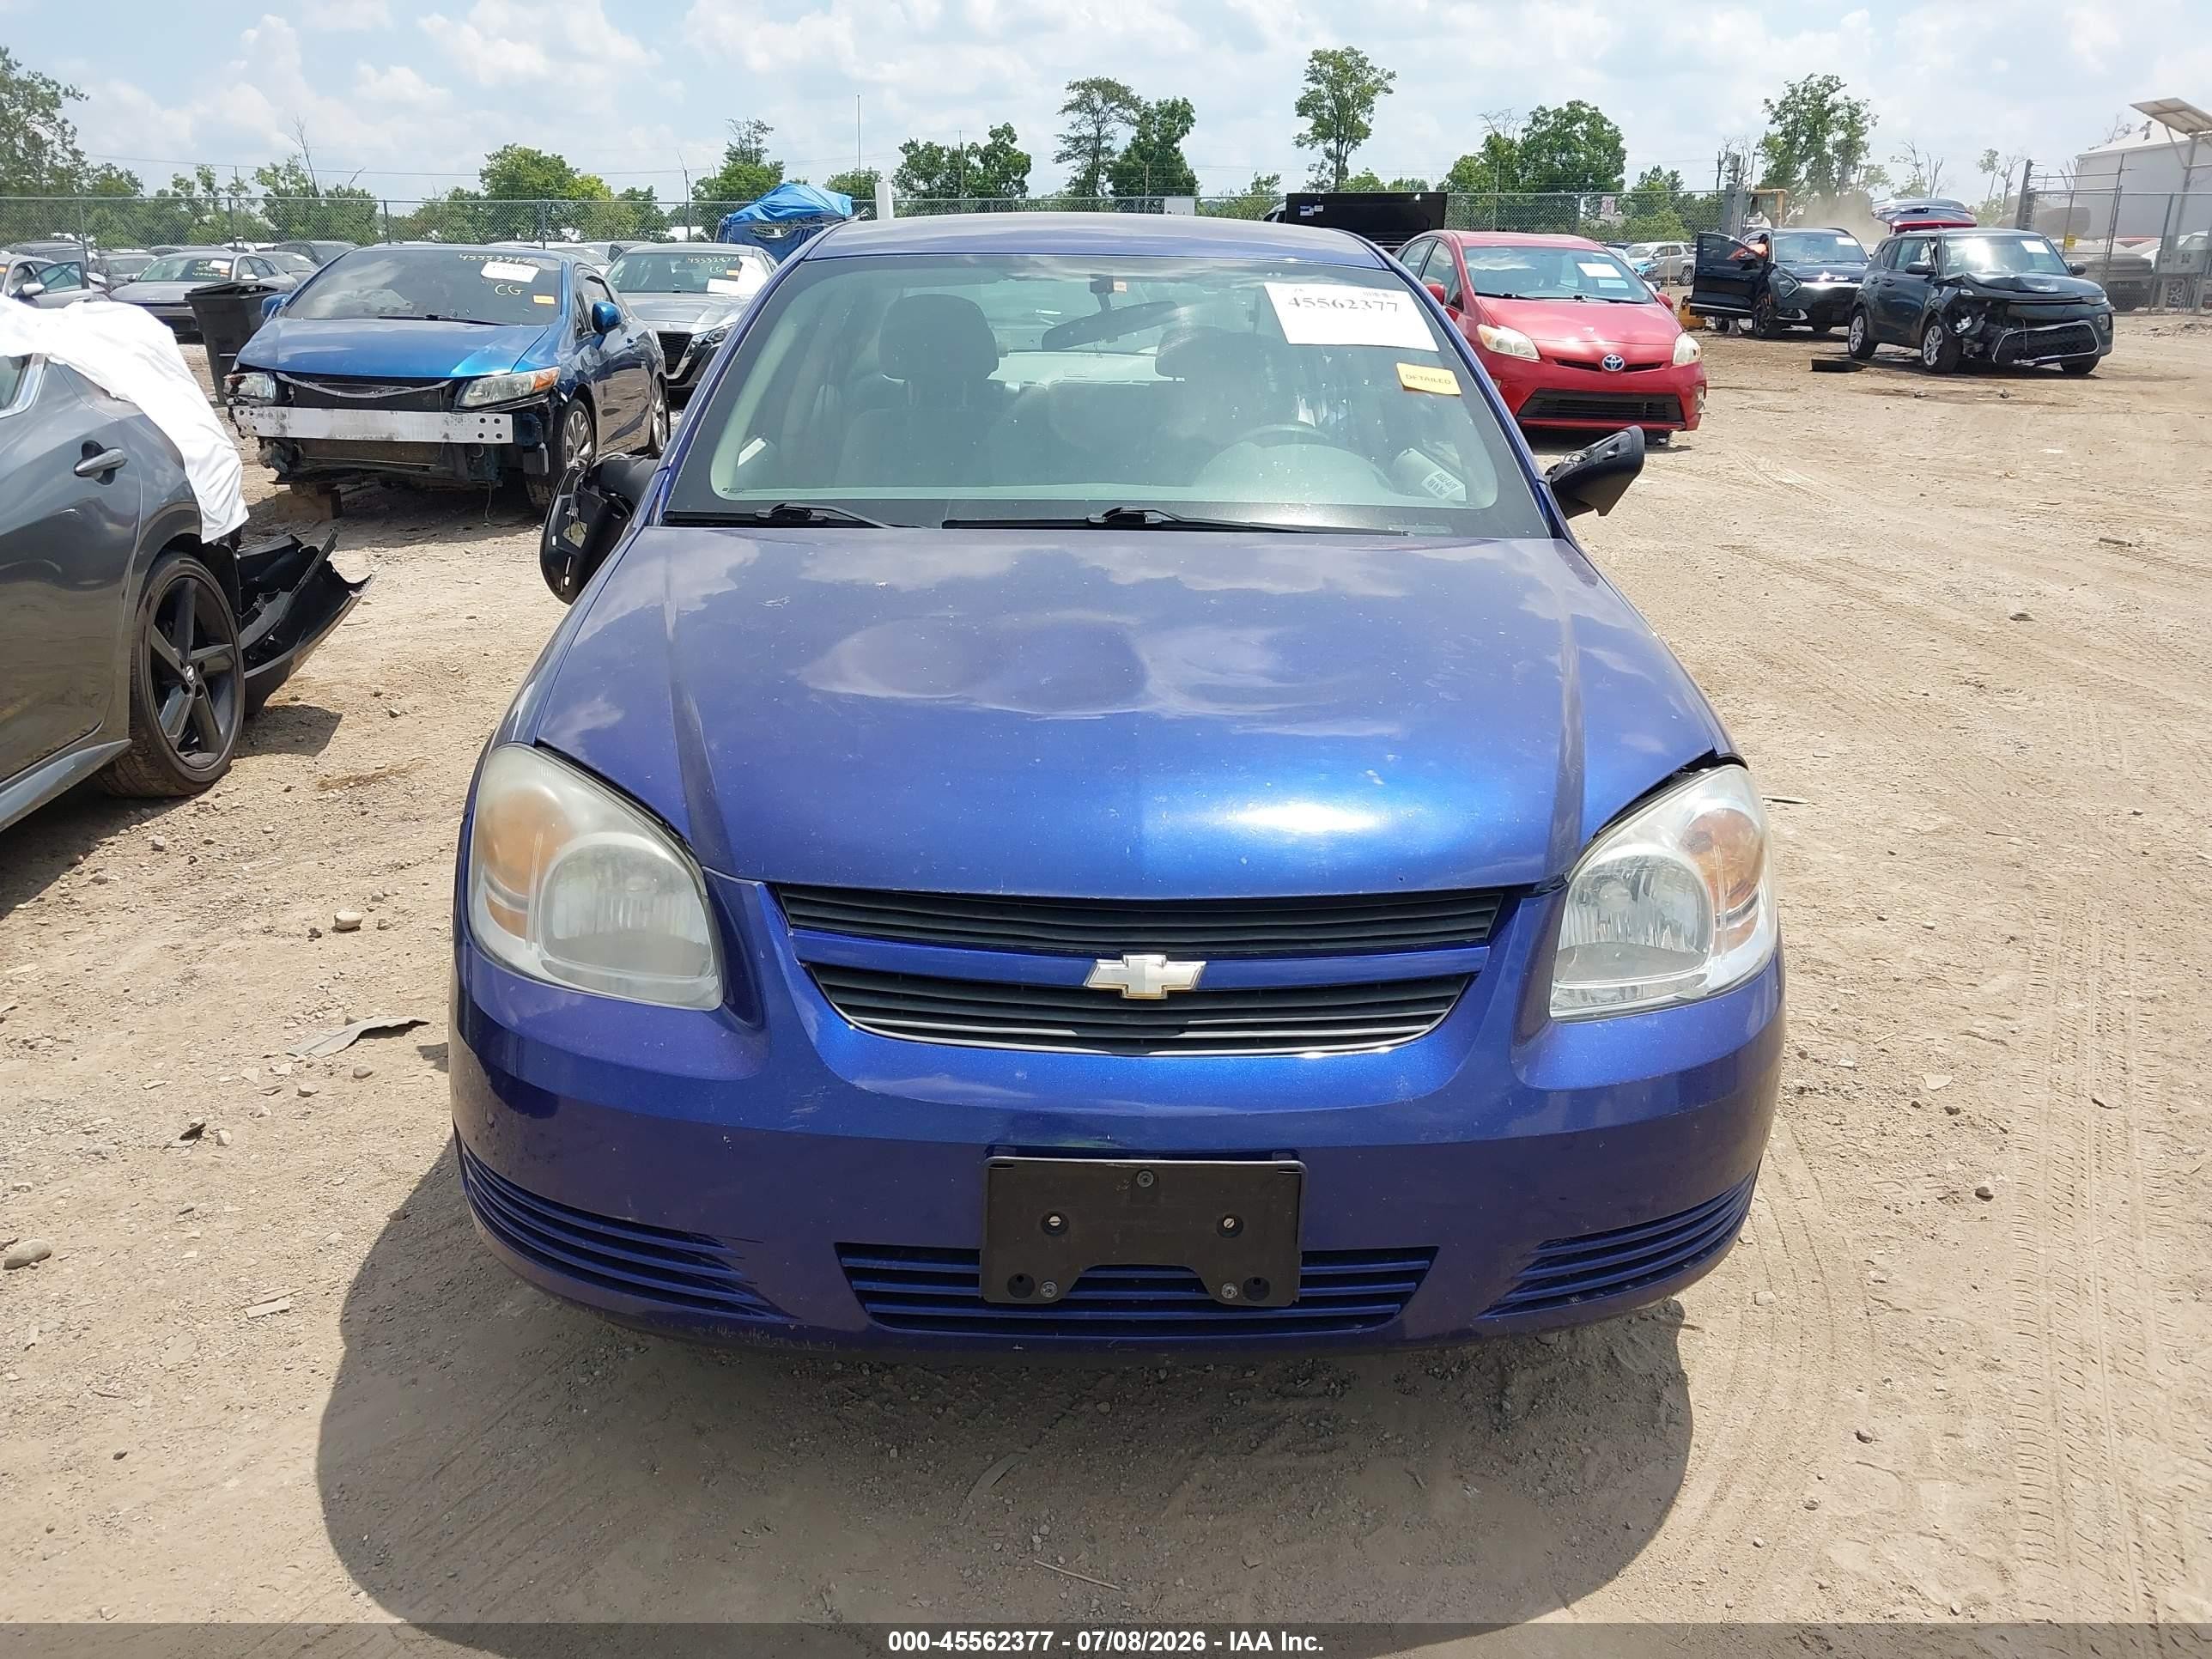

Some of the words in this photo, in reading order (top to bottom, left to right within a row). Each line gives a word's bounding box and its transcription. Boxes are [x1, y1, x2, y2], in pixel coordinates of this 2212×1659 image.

[495, 283, 526, 296] CG
[1288, 296, 1398, 313] 45562377
[1405, 373, 1452, 386] DETAILED
